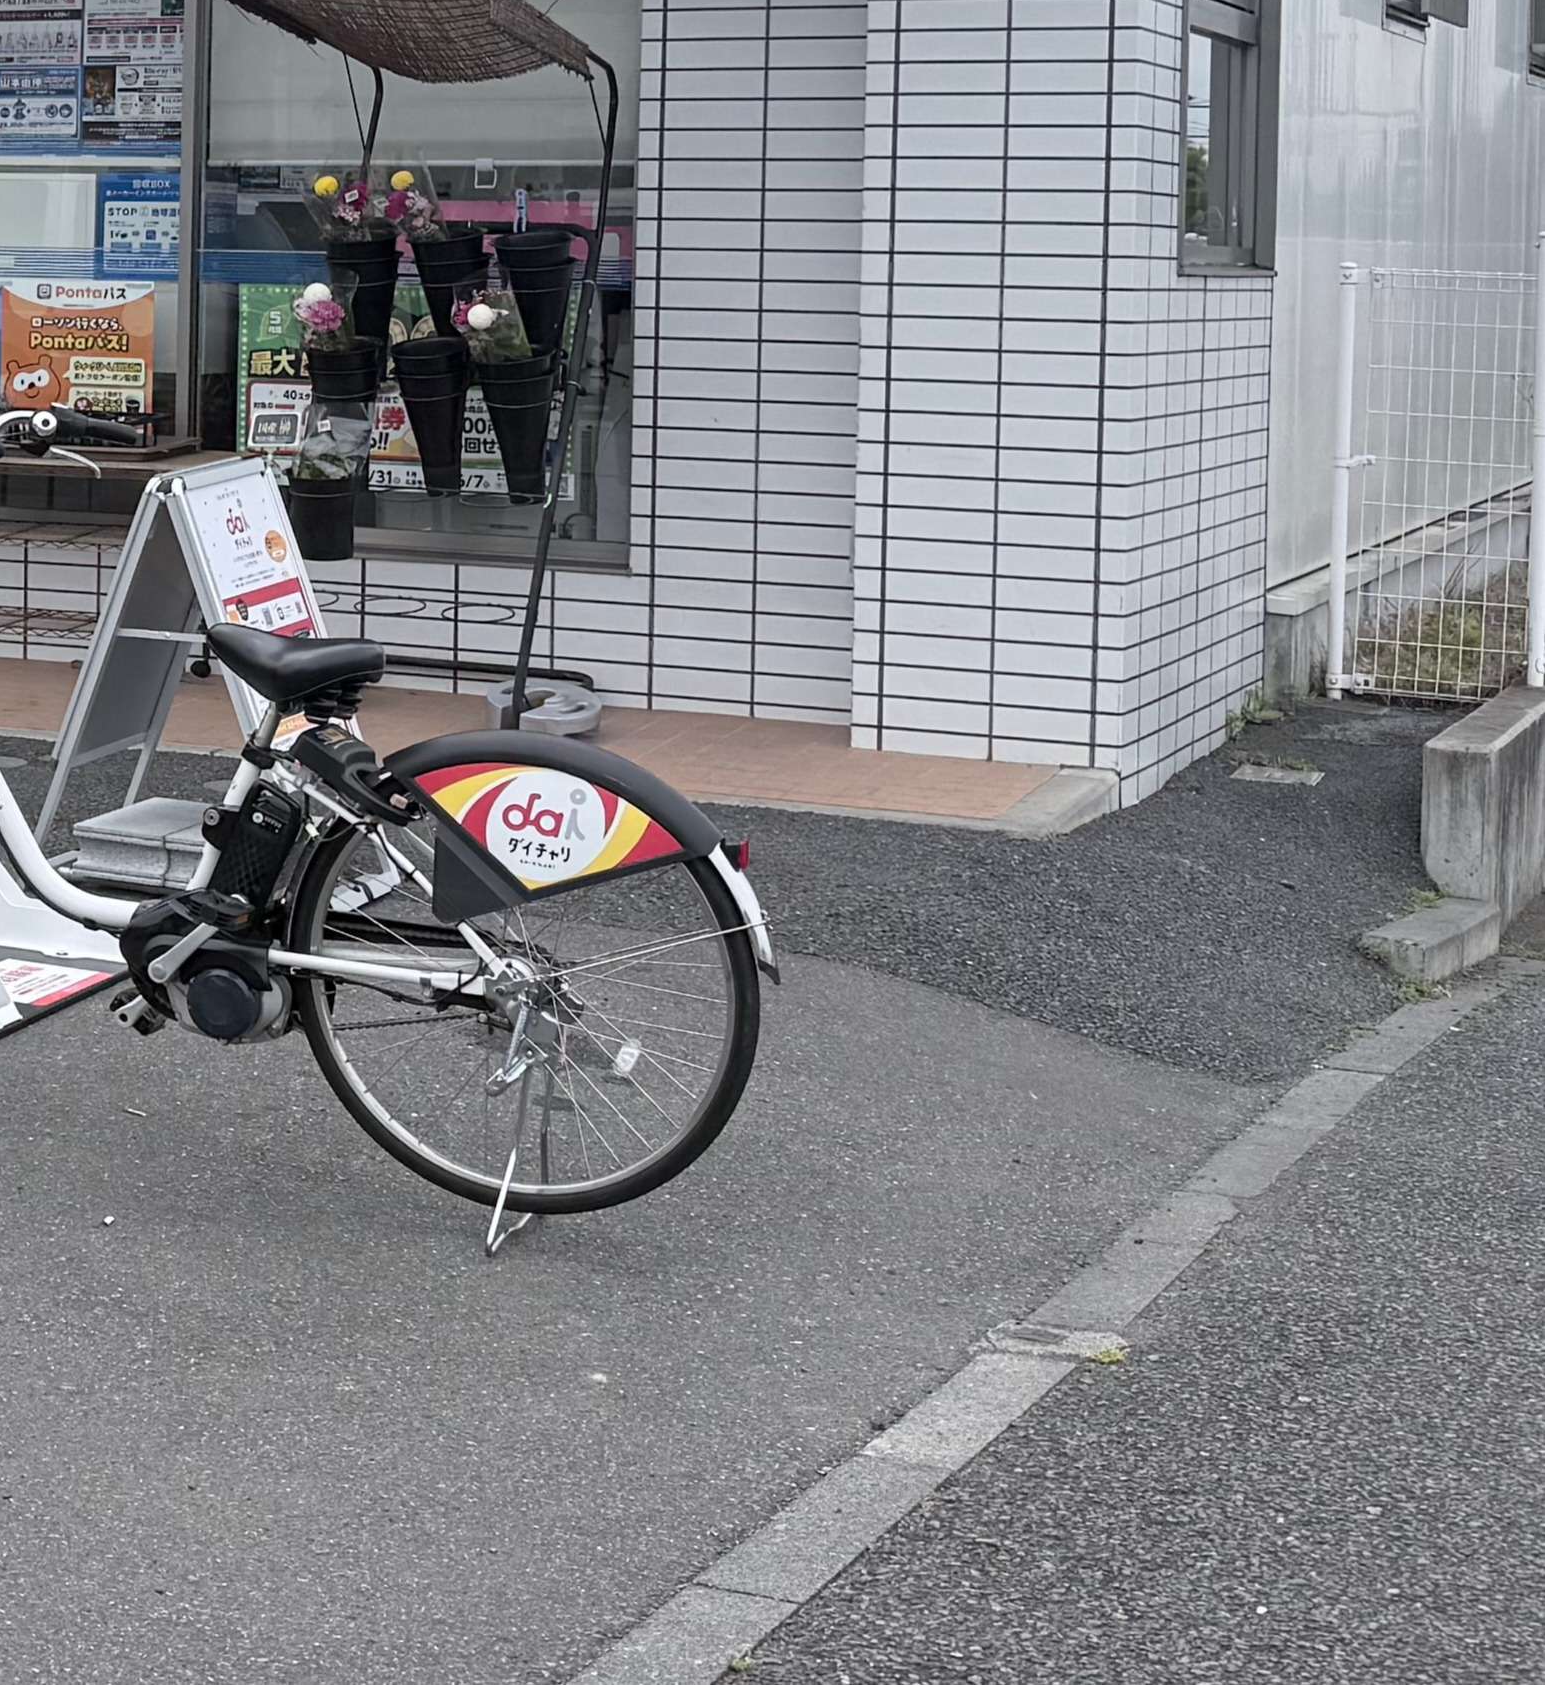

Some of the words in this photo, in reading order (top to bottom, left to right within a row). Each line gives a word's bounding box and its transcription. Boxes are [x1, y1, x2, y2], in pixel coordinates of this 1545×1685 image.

[107, 207, 138, 217] STOP
[56, 286, 127, 300] Pontaパス
[30, 332, 129, 352] Pontaパス!
[250, 348, 296, 377] 最大
[502, 788, 587, 841] dai
[508, 838, 571, 863] ダイチャリ
